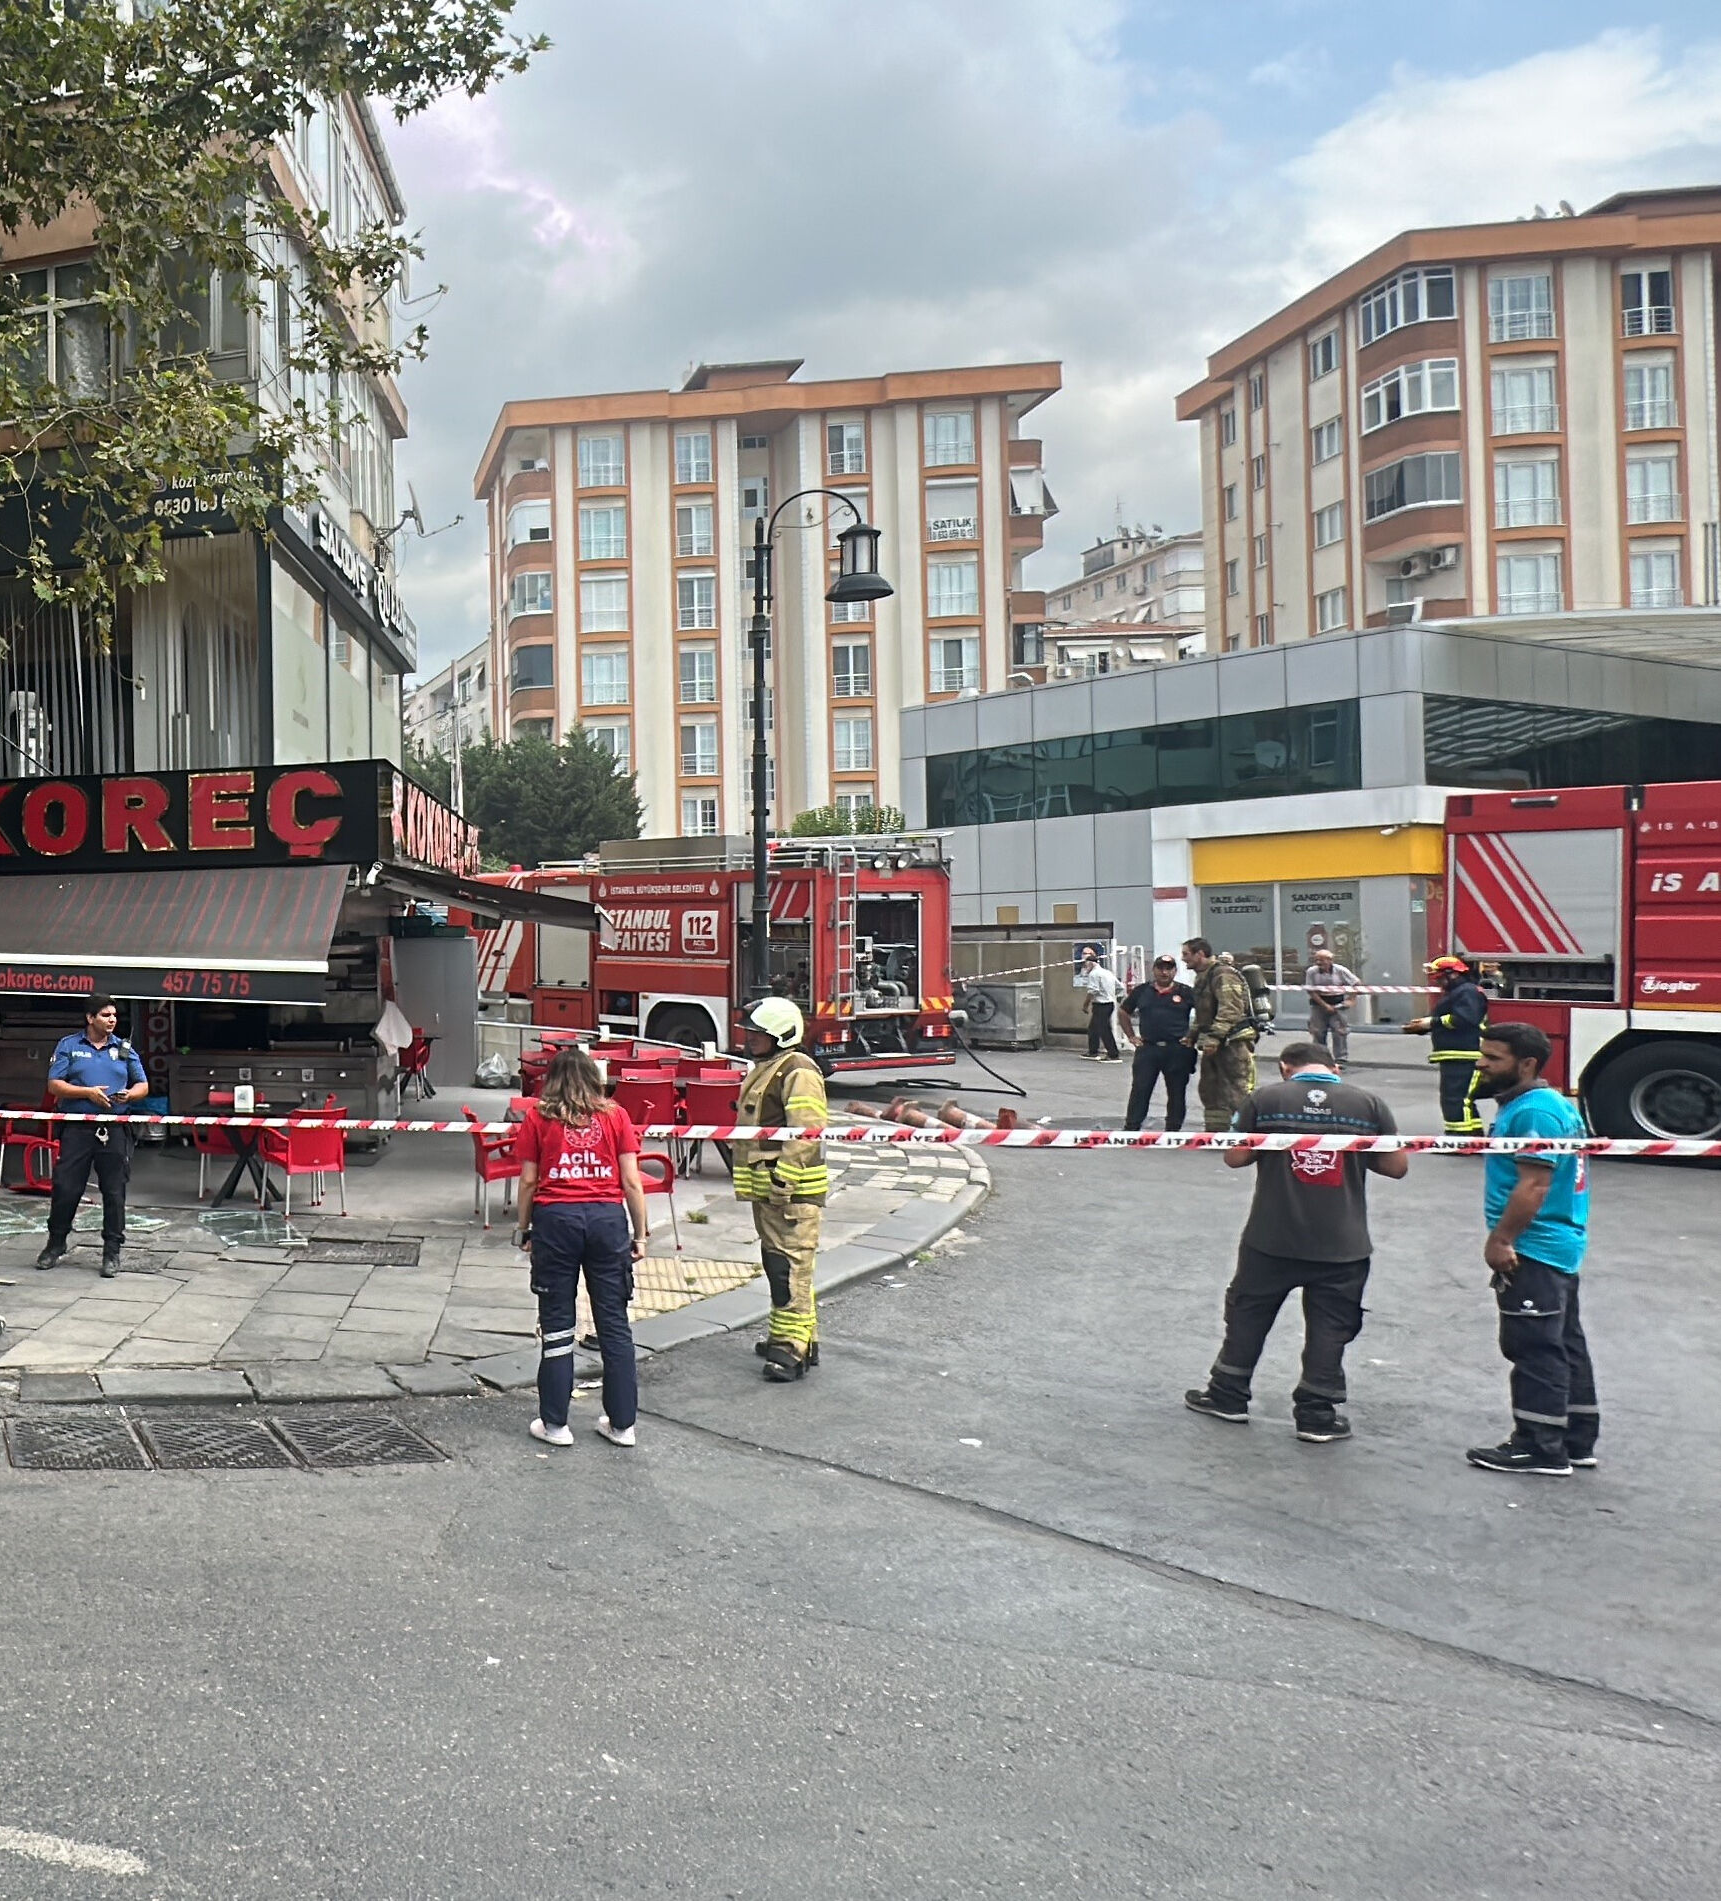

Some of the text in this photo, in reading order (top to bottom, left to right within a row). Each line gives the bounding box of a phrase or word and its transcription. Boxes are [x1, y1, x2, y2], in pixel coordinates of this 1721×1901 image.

[1210, 906, 1222, 914] VE
[607, 909, 671, 930] STANBUL
[688, 916, 712, 936] 112
[162, 972, 194, 993] 457
[201, 973, 222, 994] 75
[229, 974, 251, 995] 75
[559, 1150, 602, 1166] ACİL
[548, 1165, 613, 1180] SAĞLIK
